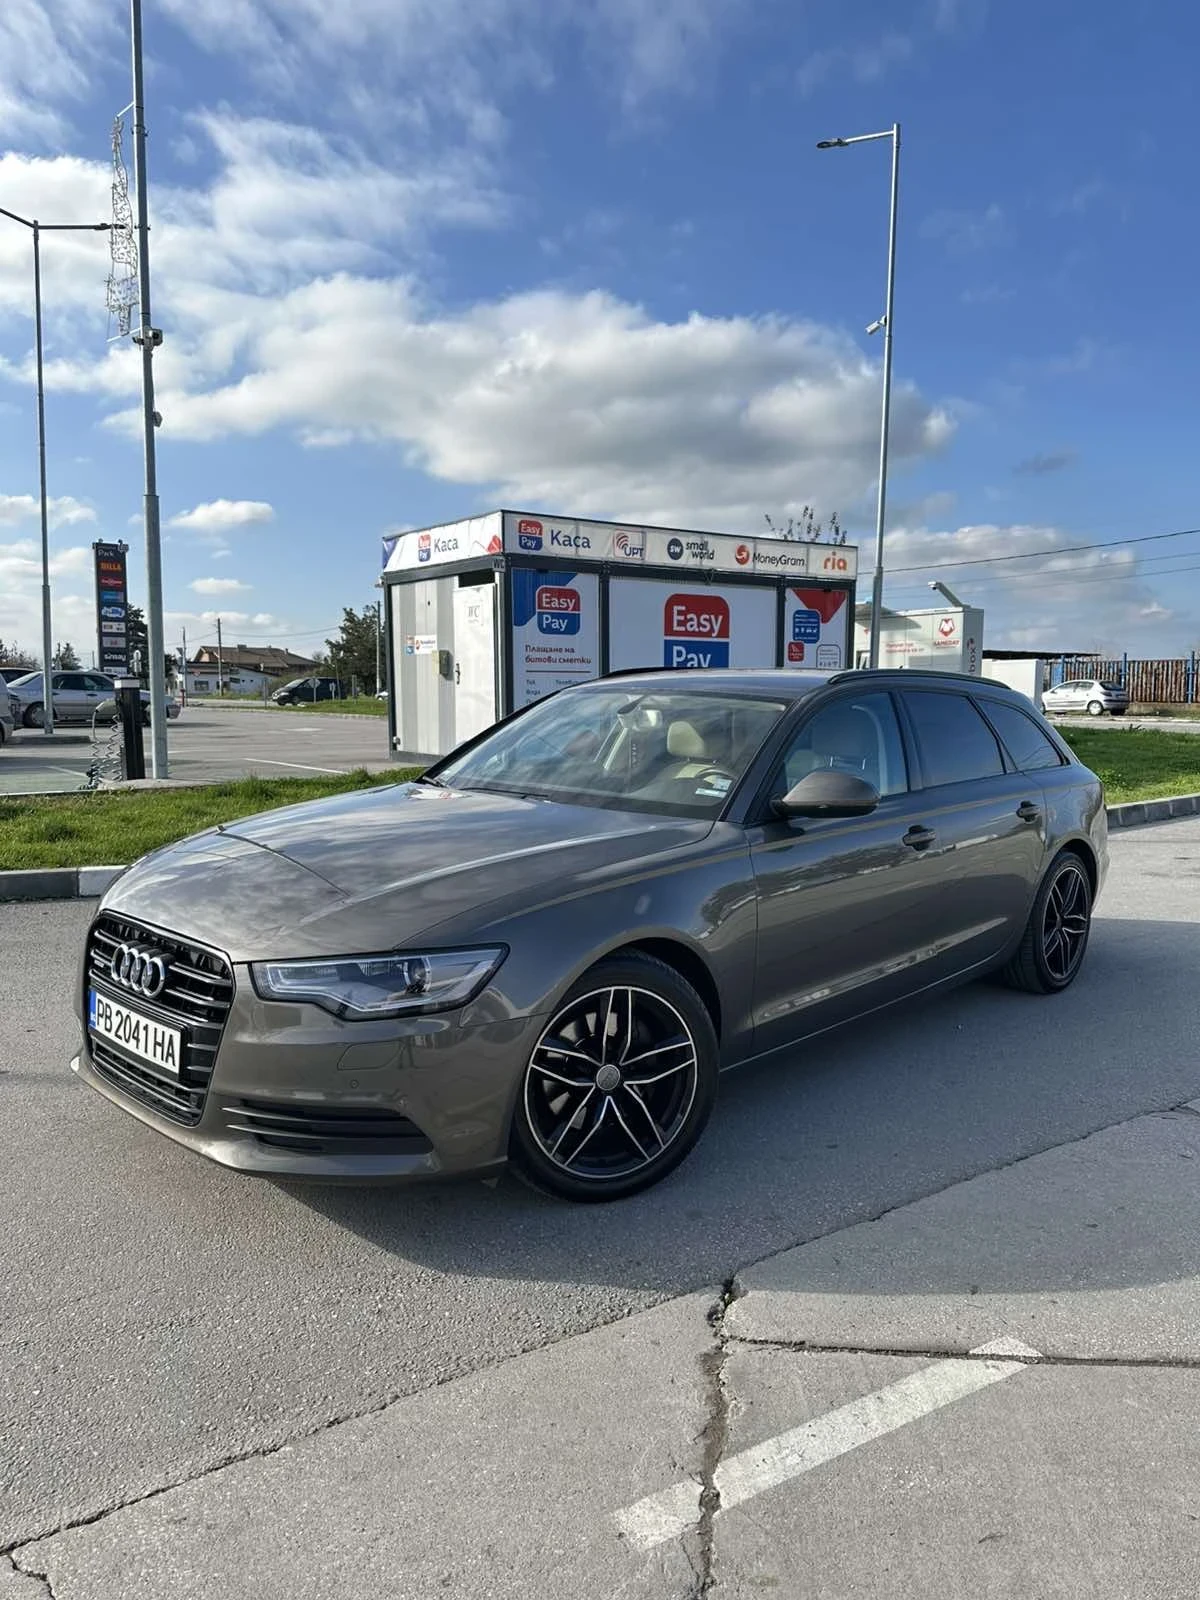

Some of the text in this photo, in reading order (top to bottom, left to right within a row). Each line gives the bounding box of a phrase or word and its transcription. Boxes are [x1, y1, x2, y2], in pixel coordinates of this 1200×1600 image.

[520, 523, 541, 535] Easy
[521, 538, 537, 549] Pay
[550, 529, 591, 549] Каса
[685, 540, 709, 551] small
[624, 546, 644, 557] UPT
[691, 549, 715, 561] world
[752, 551, 806, 568] MoneyGram
[823, 551, 848, 571] ria
[542, 593, 576, 611] Easy
[542, 614, 568, 632] Pay
[672, 605, 723, 637] Easy
[114, 1009, 149, 1055] 2041
[153, 1026, 176, 1067] HA
